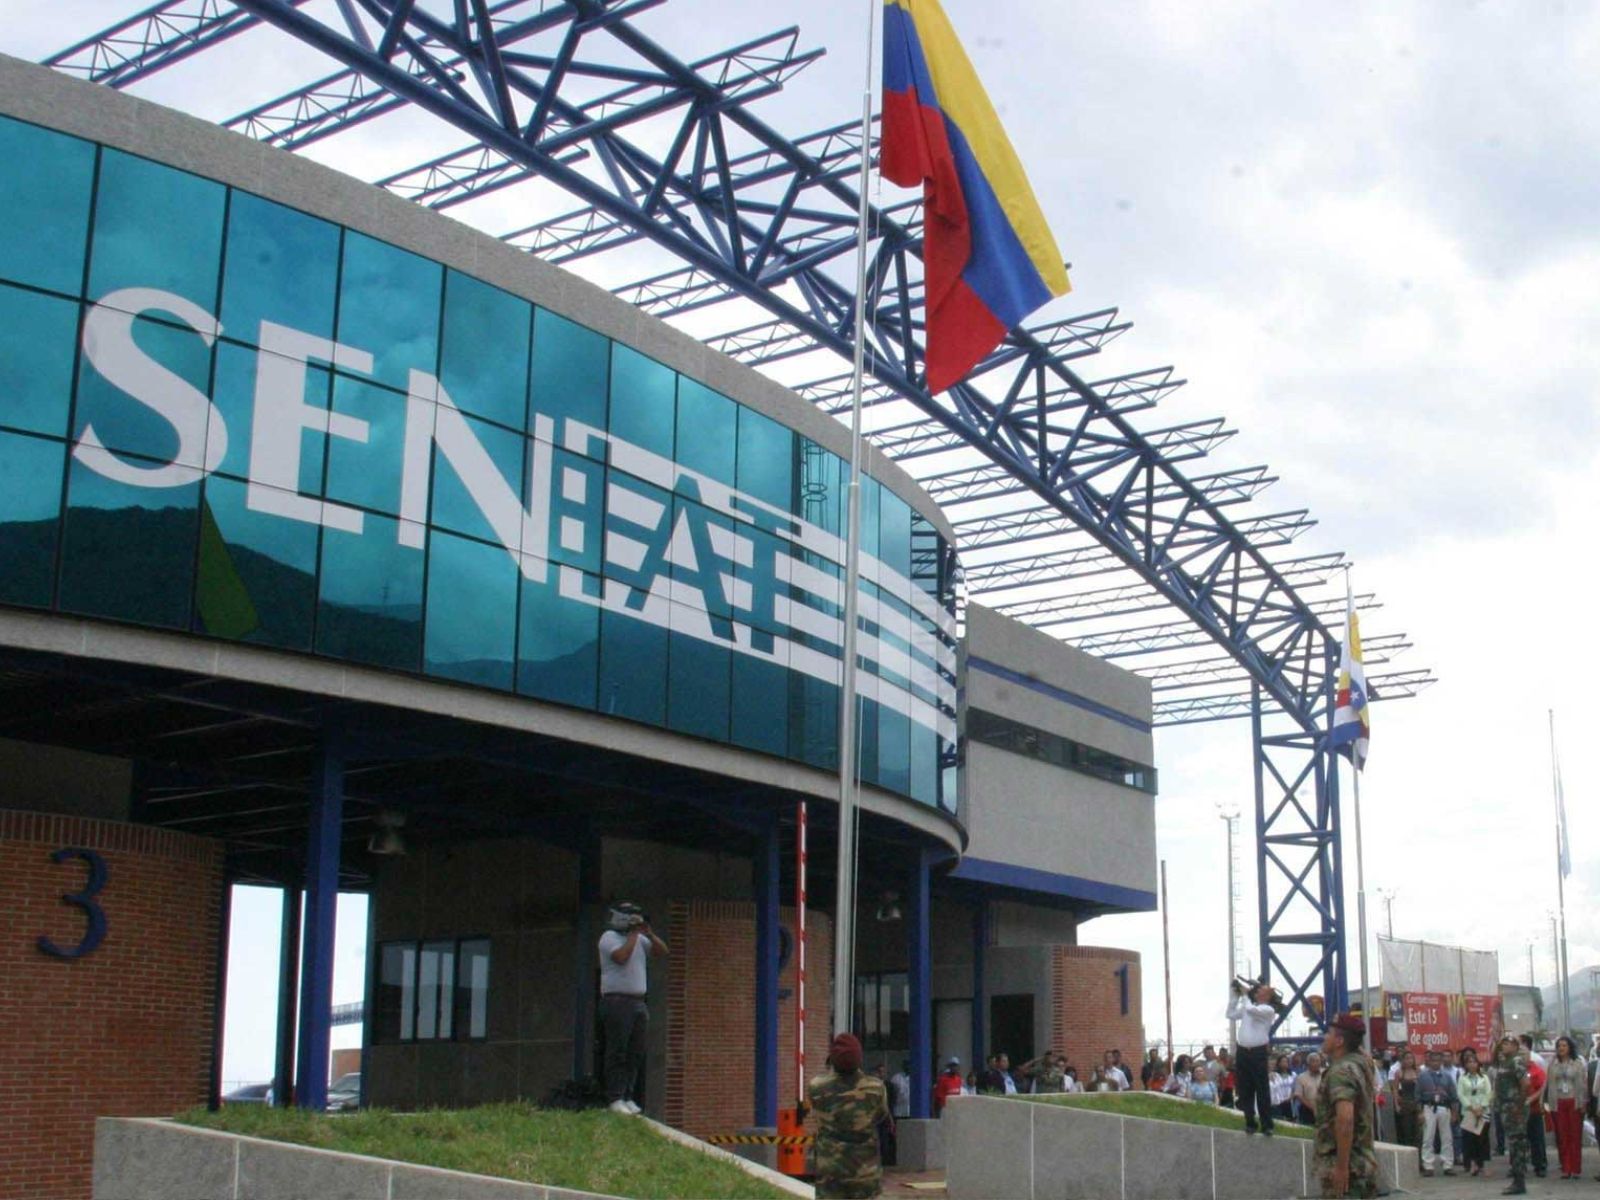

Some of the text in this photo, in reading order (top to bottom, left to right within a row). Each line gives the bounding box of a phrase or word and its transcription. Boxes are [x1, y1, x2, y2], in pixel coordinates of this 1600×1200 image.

[72, 286, 802, 656] SENIAT
[37, 847, 108, 958] 3
[1114, 962, 1128, 1015] 1
[1408, 1007, 1437, 1024] Este 15
[1410, 1029, 1449, 1050] de agosto
